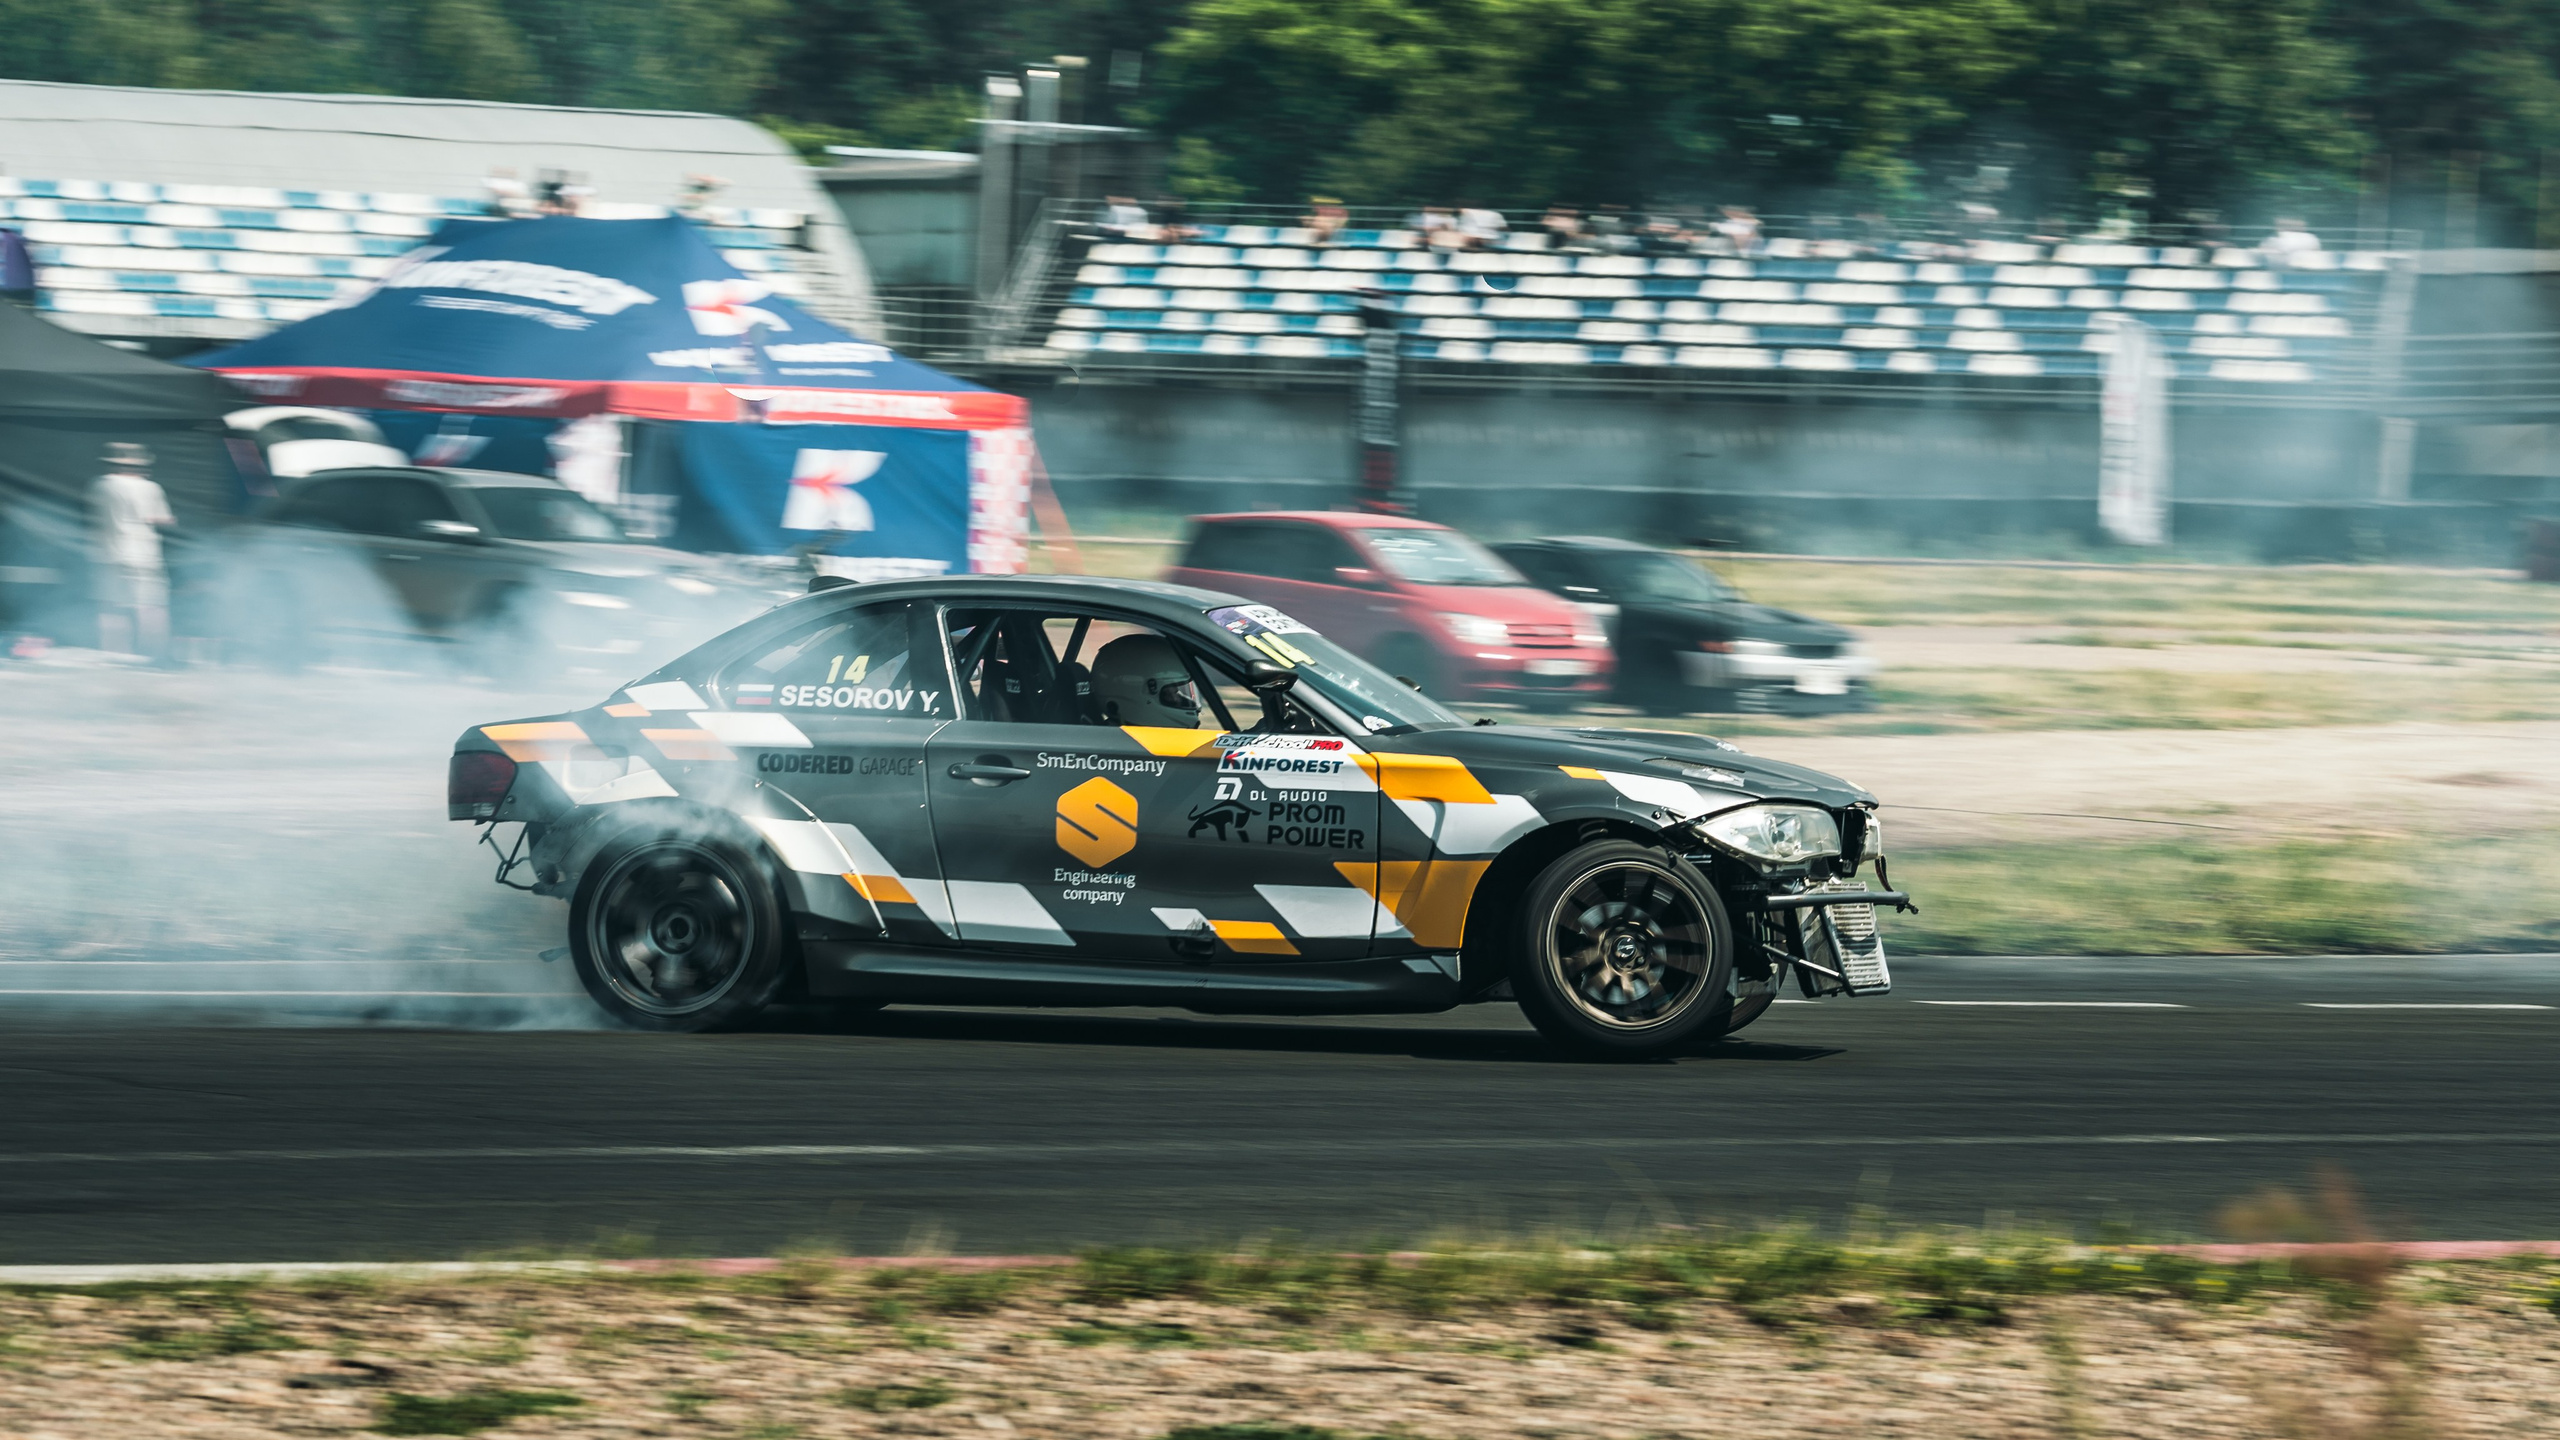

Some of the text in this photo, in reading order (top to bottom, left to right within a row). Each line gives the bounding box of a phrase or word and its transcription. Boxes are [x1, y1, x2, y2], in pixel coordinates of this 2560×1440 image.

[1244, 632, 1316, 669] 14
[826, 655, 870, 684] 14
[779, 685, 914, 711] SESOROV
[757, 753, 916, 776] CODERED GARAGE
[1036, 752, 1167, 777] SmEnCompany
[1221, 750, 1344, 773] KINFOREST
[1279, 790, 1328, 802] AUDIO
[1268, 802, 1346, 825] PROM
[1266, 825, 1365, 850] POWER
[1053, 868, 1136, 889] Engineering
[1062, 889, 1126, 905] company
